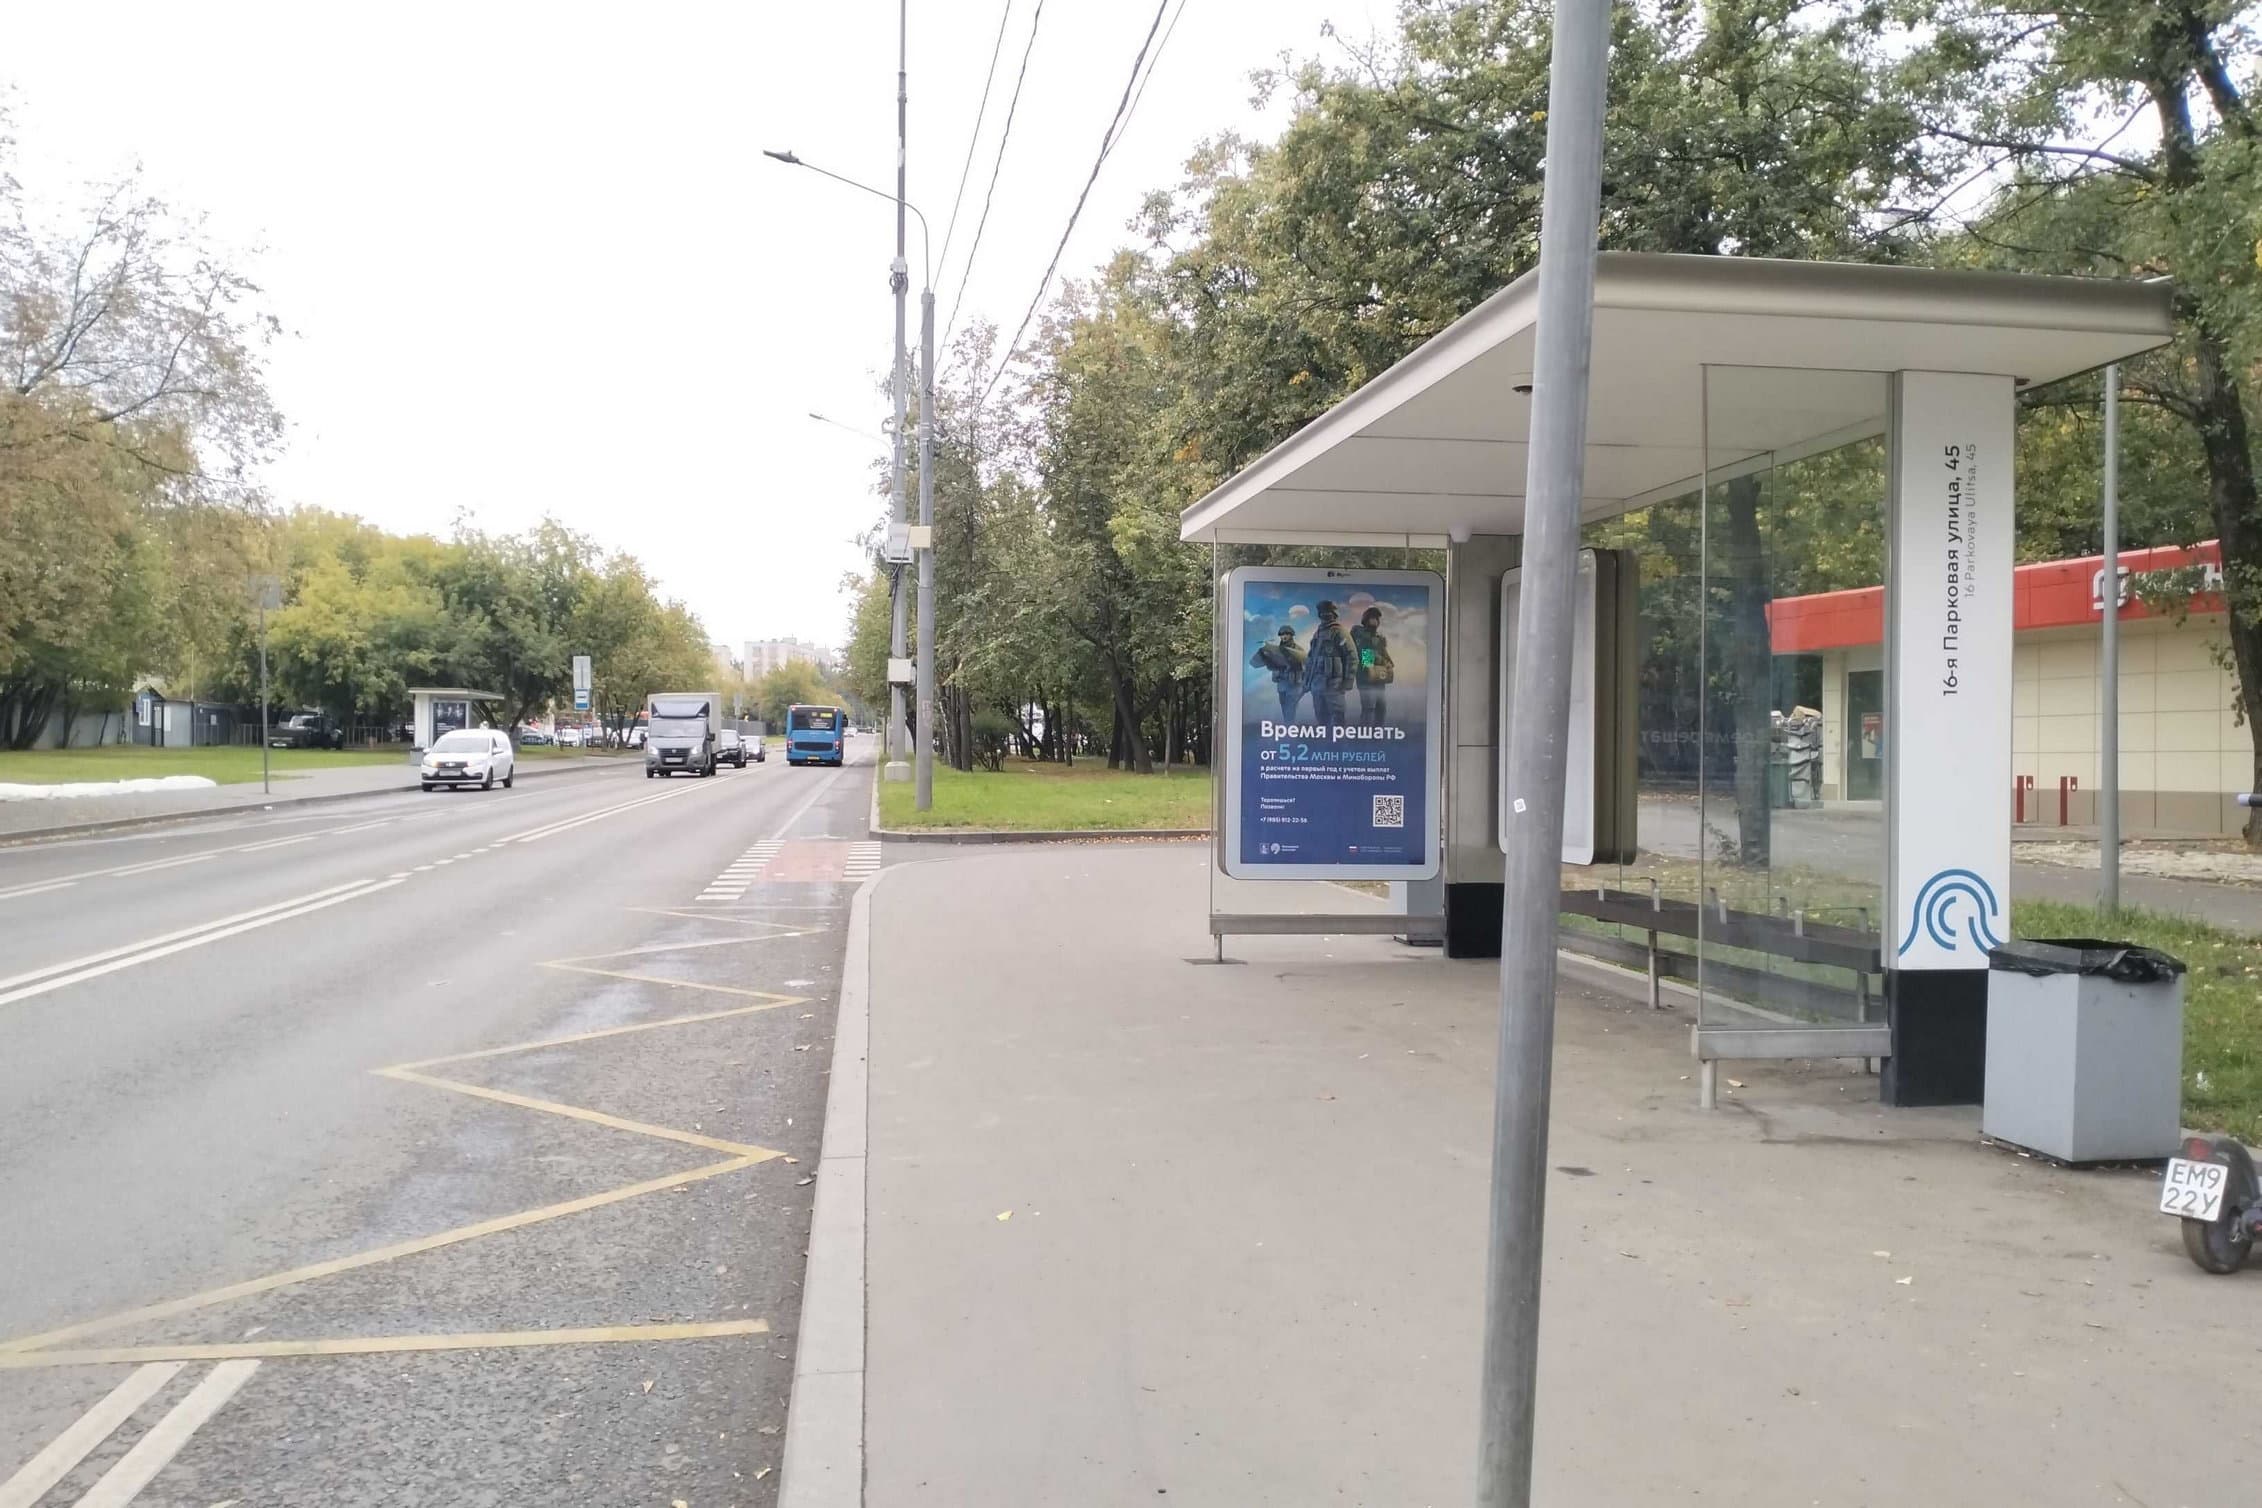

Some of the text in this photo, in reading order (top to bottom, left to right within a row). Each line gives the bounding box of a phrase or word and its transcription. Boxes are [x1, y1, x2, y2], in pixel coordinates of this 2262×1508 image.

[1965, 443, 1976, 461] 45
[1964, 511, 1978, 581] Parkovaya
[1943, 445, 1962, 696] 16-я Парковая улица, 45
[1964, 584, 1975, 597] 16
[1260, 720, 1405, 742] Время решать
[1278, 743, 1309, 764] 5,2
[1311, 751, 1339, 762] МЛН
[1341, 750, 1386, 762] РУБЛЕЙ
